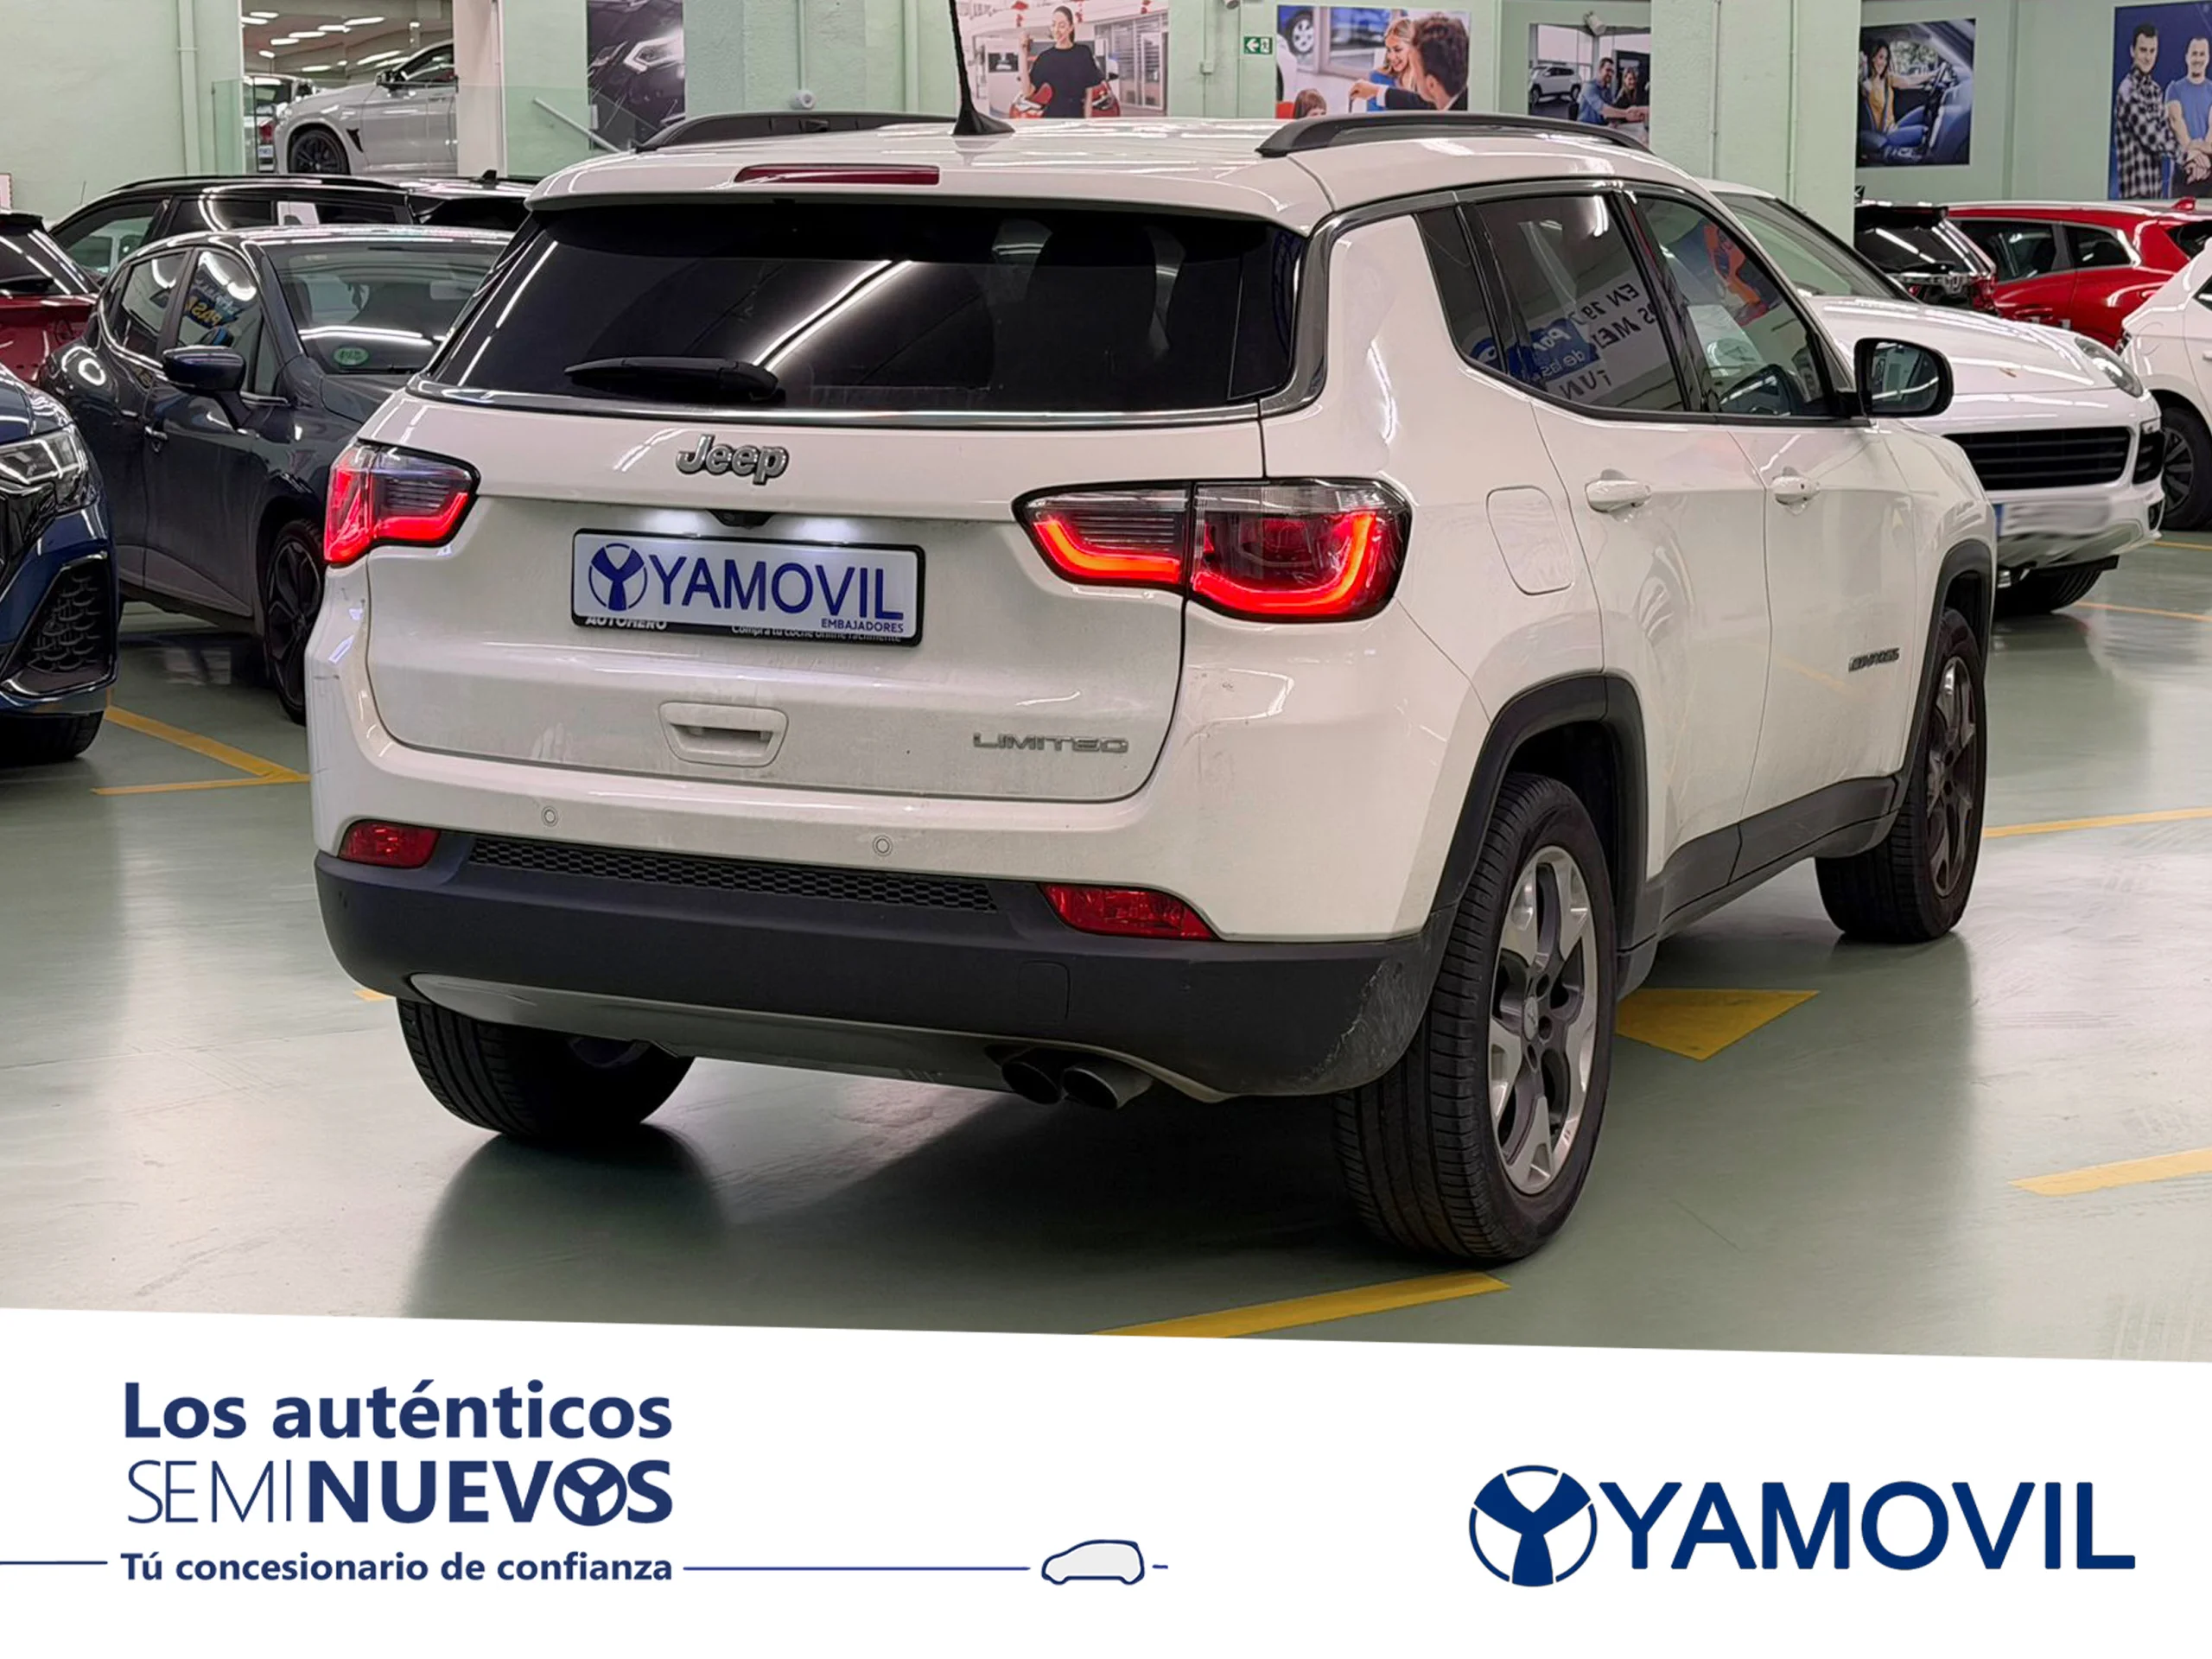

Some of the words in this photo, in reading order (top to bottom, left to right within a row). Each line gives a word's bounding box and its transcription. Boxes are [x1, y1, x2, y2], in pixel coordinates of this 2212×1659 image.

[676, 434, 790, 486] Jeep
[649, 555, 904, 620] YAMOVIL
[821, 618, 904, 633] EMBAJADORES
[973, 732, 1129, 753] LIMITED
